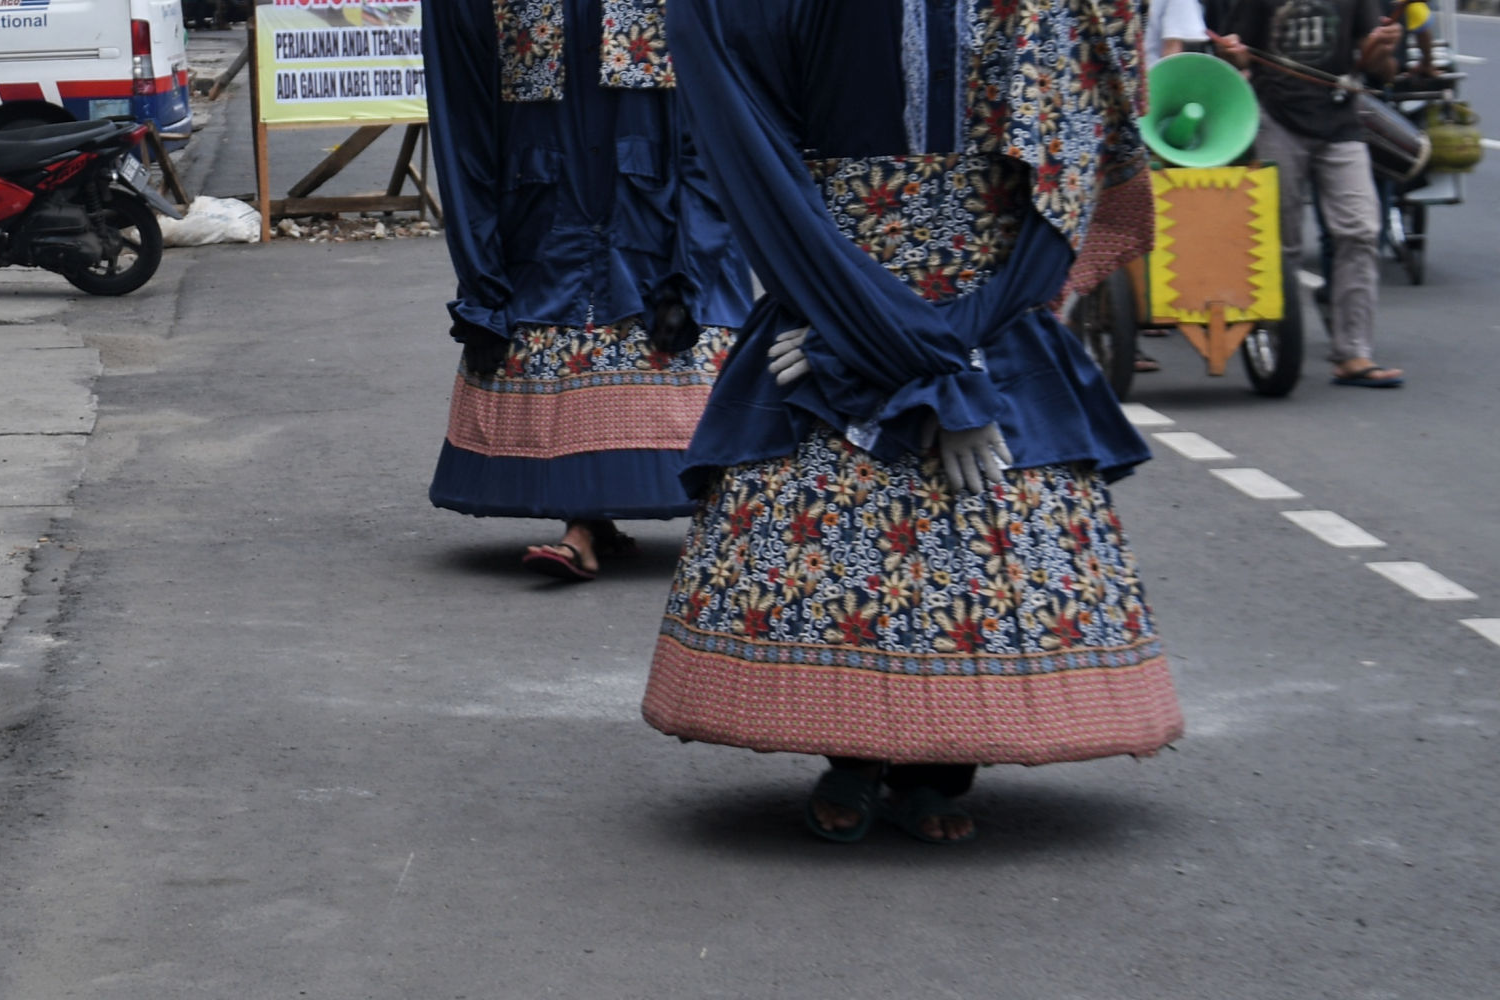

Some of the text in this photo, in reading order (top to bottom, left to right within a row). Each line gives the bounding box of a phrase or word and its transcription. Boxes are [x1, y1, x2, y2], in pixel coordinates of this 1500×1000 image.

[275, 29, 422, 59] PERJALANAN ANDA TERGANG
[277, 72, 297, 99] ADA
[300, 71, 337, 98] GALIAN
[339, 70, 371, 97] KABEL
[374, 70, 402, 96] FIBER
